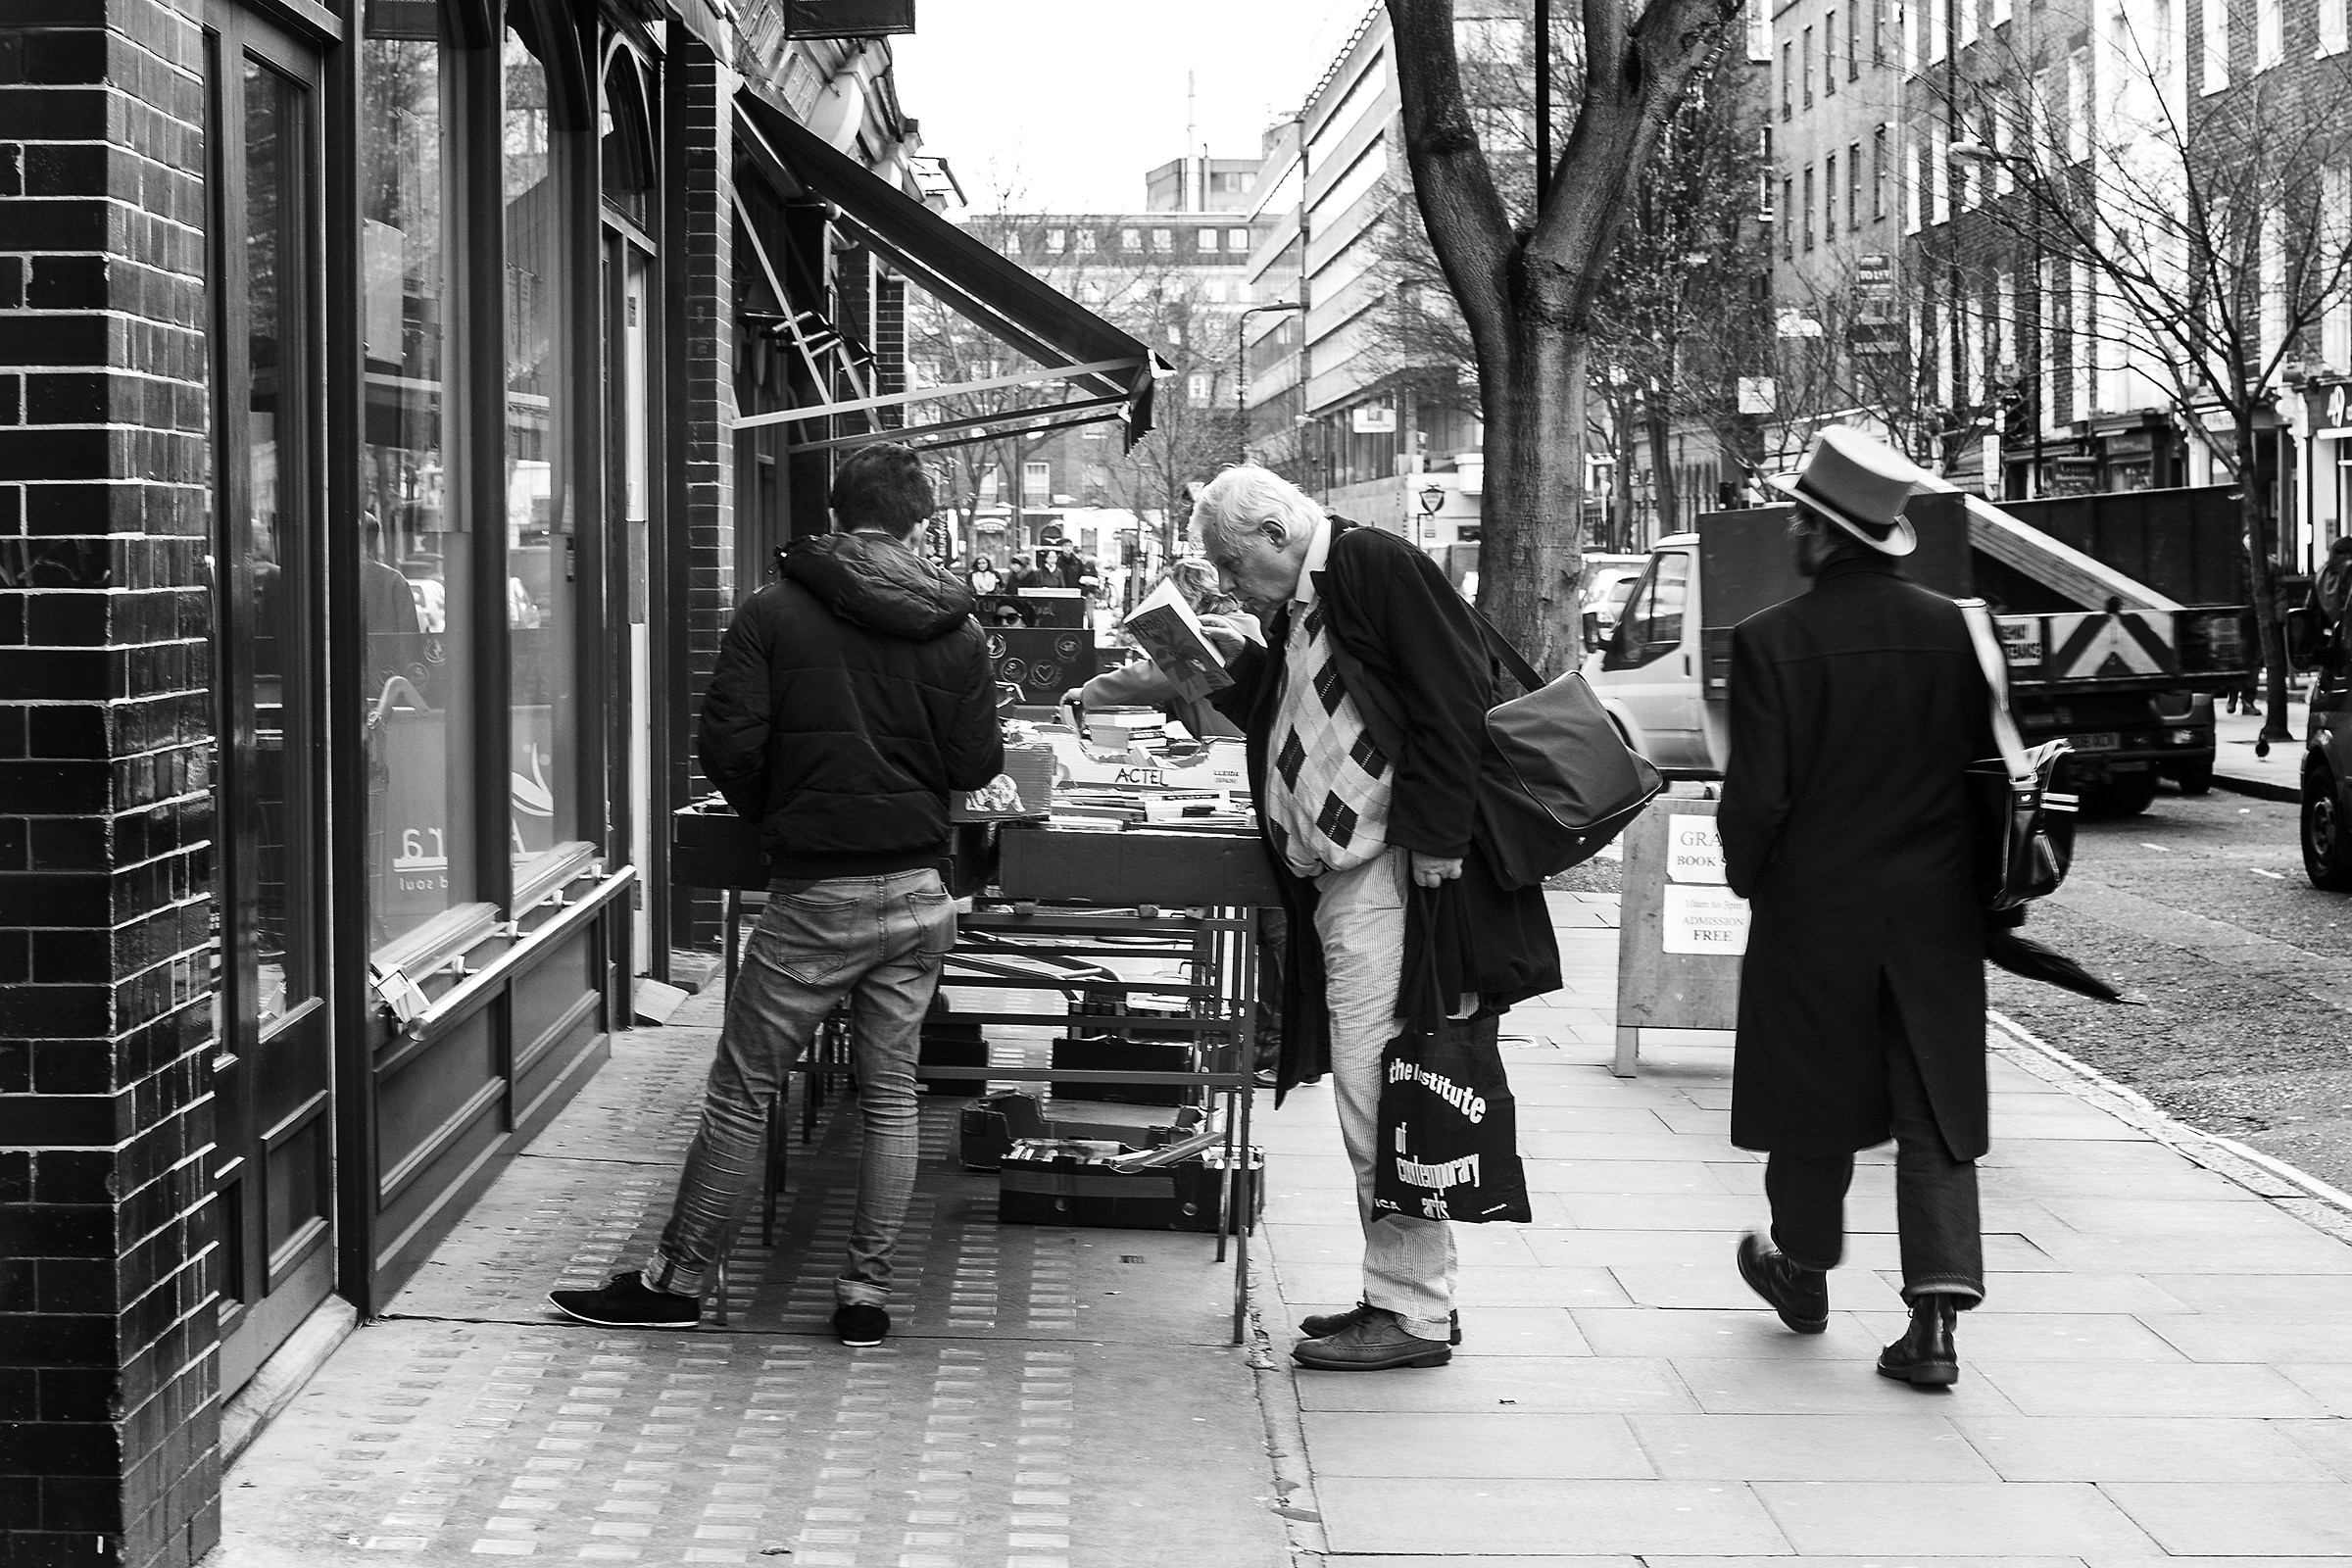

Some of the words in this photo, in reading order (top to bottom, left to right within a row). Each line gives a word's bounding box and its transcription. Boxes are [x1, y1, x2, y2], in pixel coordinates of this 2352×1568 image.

[1114, 767, 1168, 787] ACTEL
[1681, 831, 1723, 847] GRA
[1677, 856, 1716, 866] BOOK
[1683, 916, 1744, 926] ADMISSION
[1693, 930, 1733, 942] FREE
[1389, 1058, 1413, 1083] the
[1395, 1122, 1407, 1154] of
[1396, 1153, 1480, 1197] contemporary
[1421, 1193, 1450, 1219] arts
